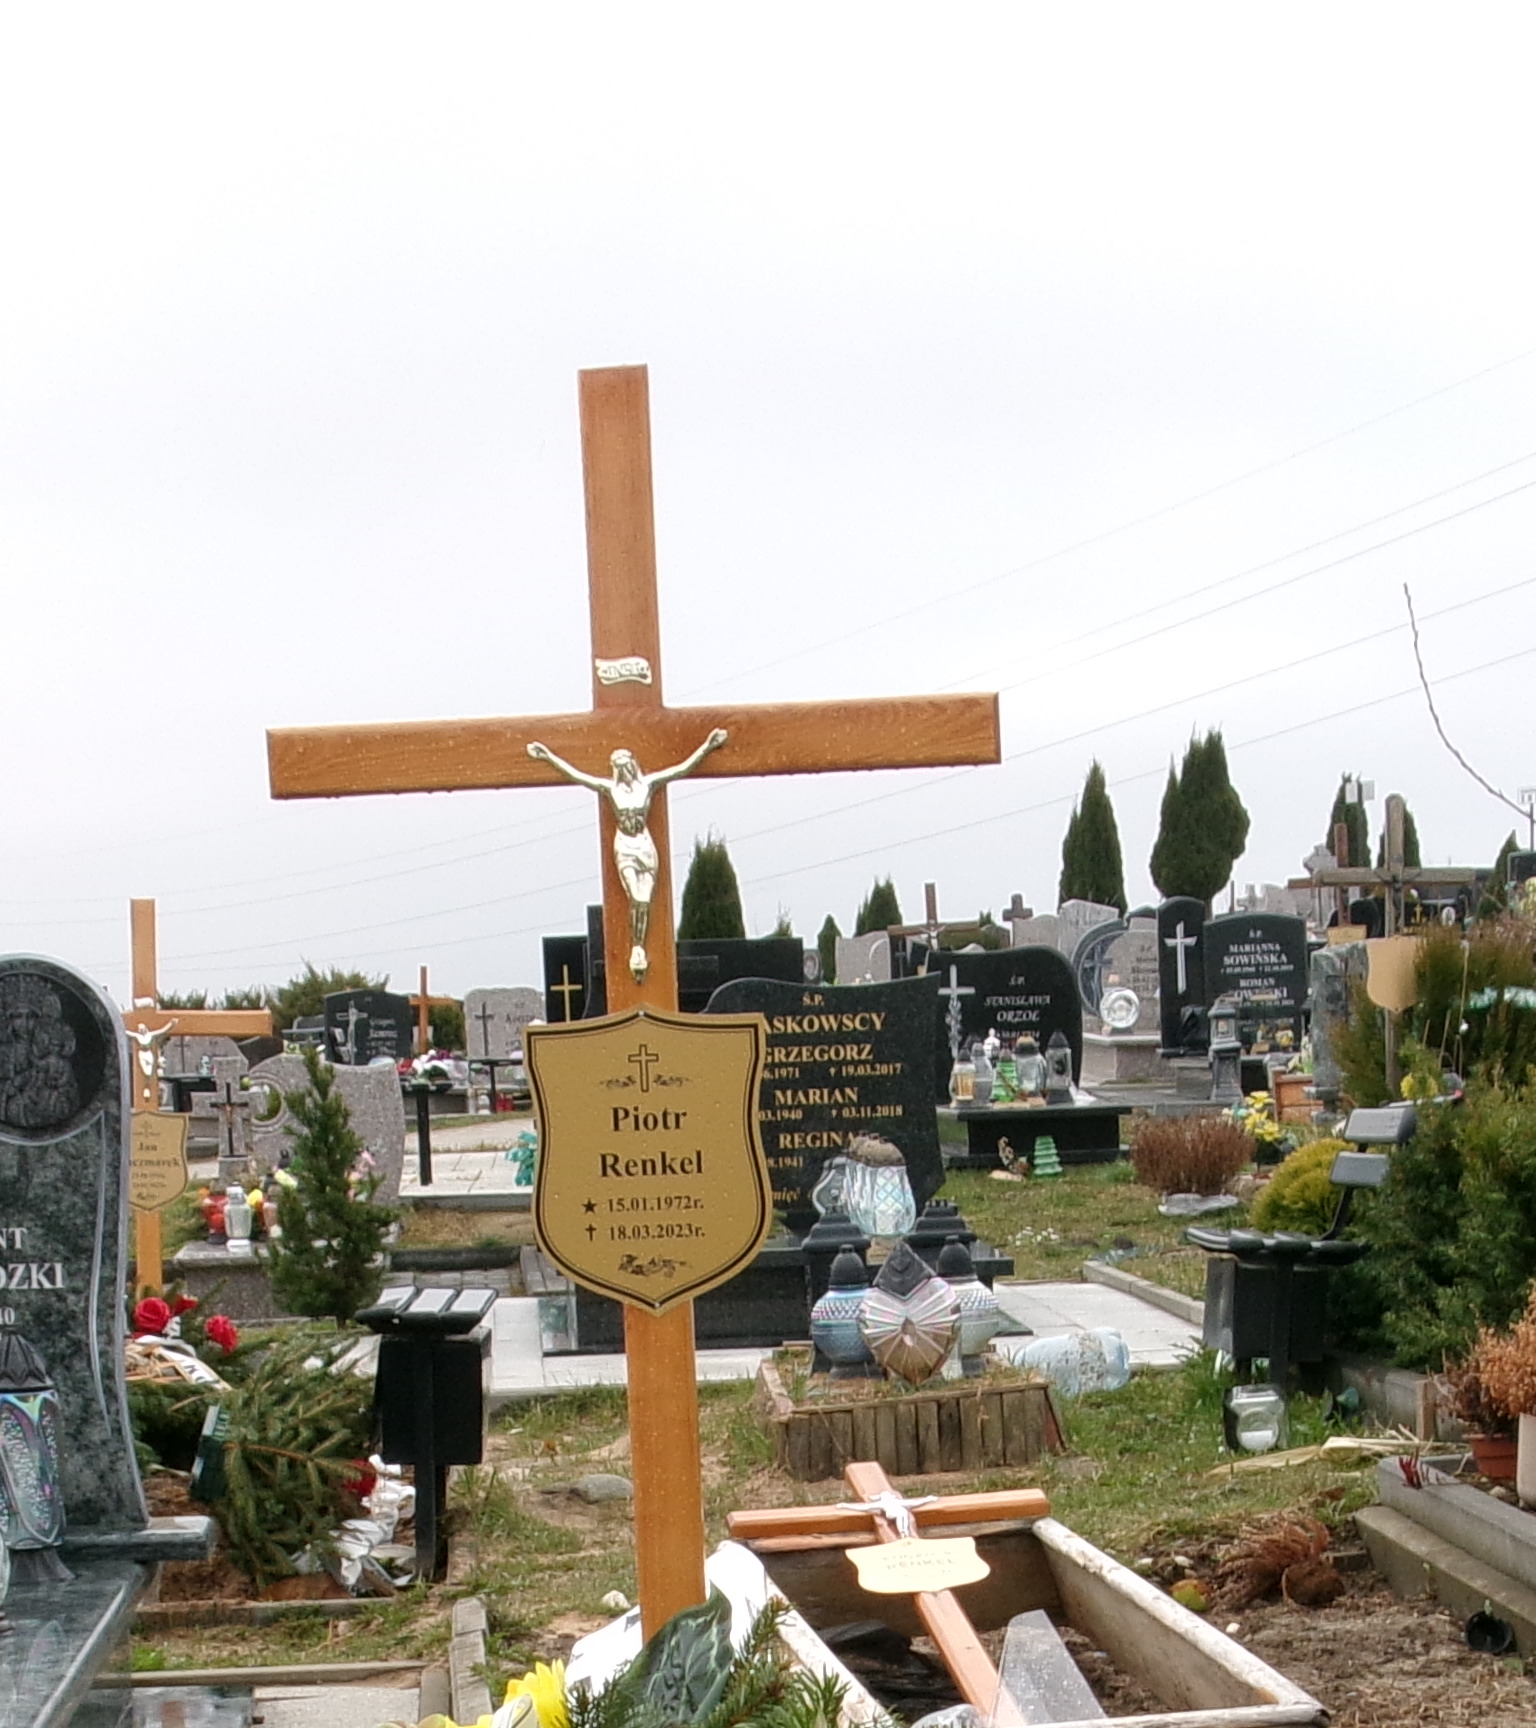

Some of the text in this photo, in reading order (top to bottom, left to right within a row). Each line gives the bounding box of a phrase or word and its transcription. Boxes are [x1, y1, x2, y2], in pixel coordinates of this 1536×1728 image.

[764, 1012, 886, 1034] ASKOWSCY
[775, 1086, 859, 1106] MARIAN
[611, 1105, 688, 1132] Piotr
[599, 1149, 704, 1178] Renkel
[607, 1195, 705, 1213] 15.01.1972r.
[609, 1222, 706, 1241] 18.03.2023r.
